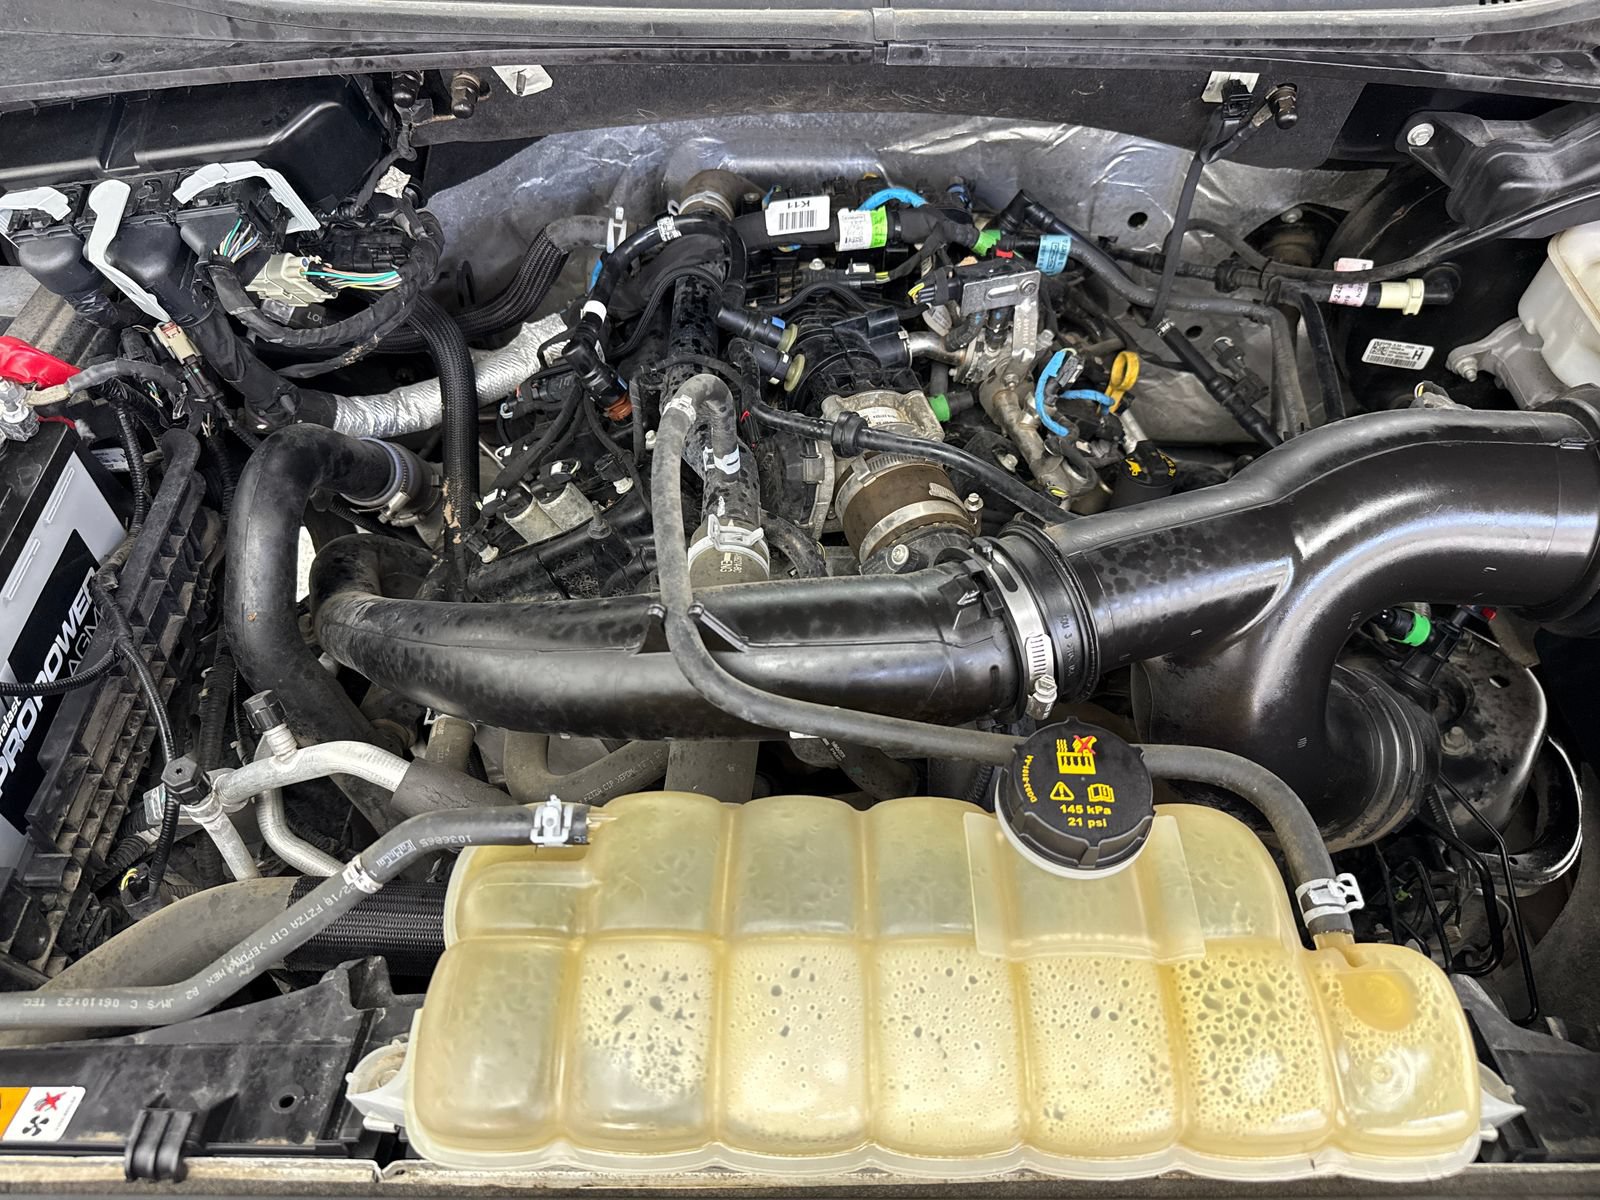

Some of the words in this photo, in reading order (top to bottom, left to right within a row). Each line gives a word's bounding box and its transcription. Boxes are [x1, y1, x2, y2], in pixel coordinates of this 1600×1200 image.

[787, 200, 810, 209] K11
[1412, 349, 1424, 360] H
[720, 560, 733, 573] ENG
[0, 694, 21, 747] ralast
[1060, 804, 1083, 814] 145
[1086, 805, 1112, 815] kPa
[1067, 817, 1083, 827] 21
[1087, 818, 1107, 829] psi
[419, 834, 472, 848] 1036865
[23, 997, 46, 1008] TEC
[130, 1000, 138, 1009] C
